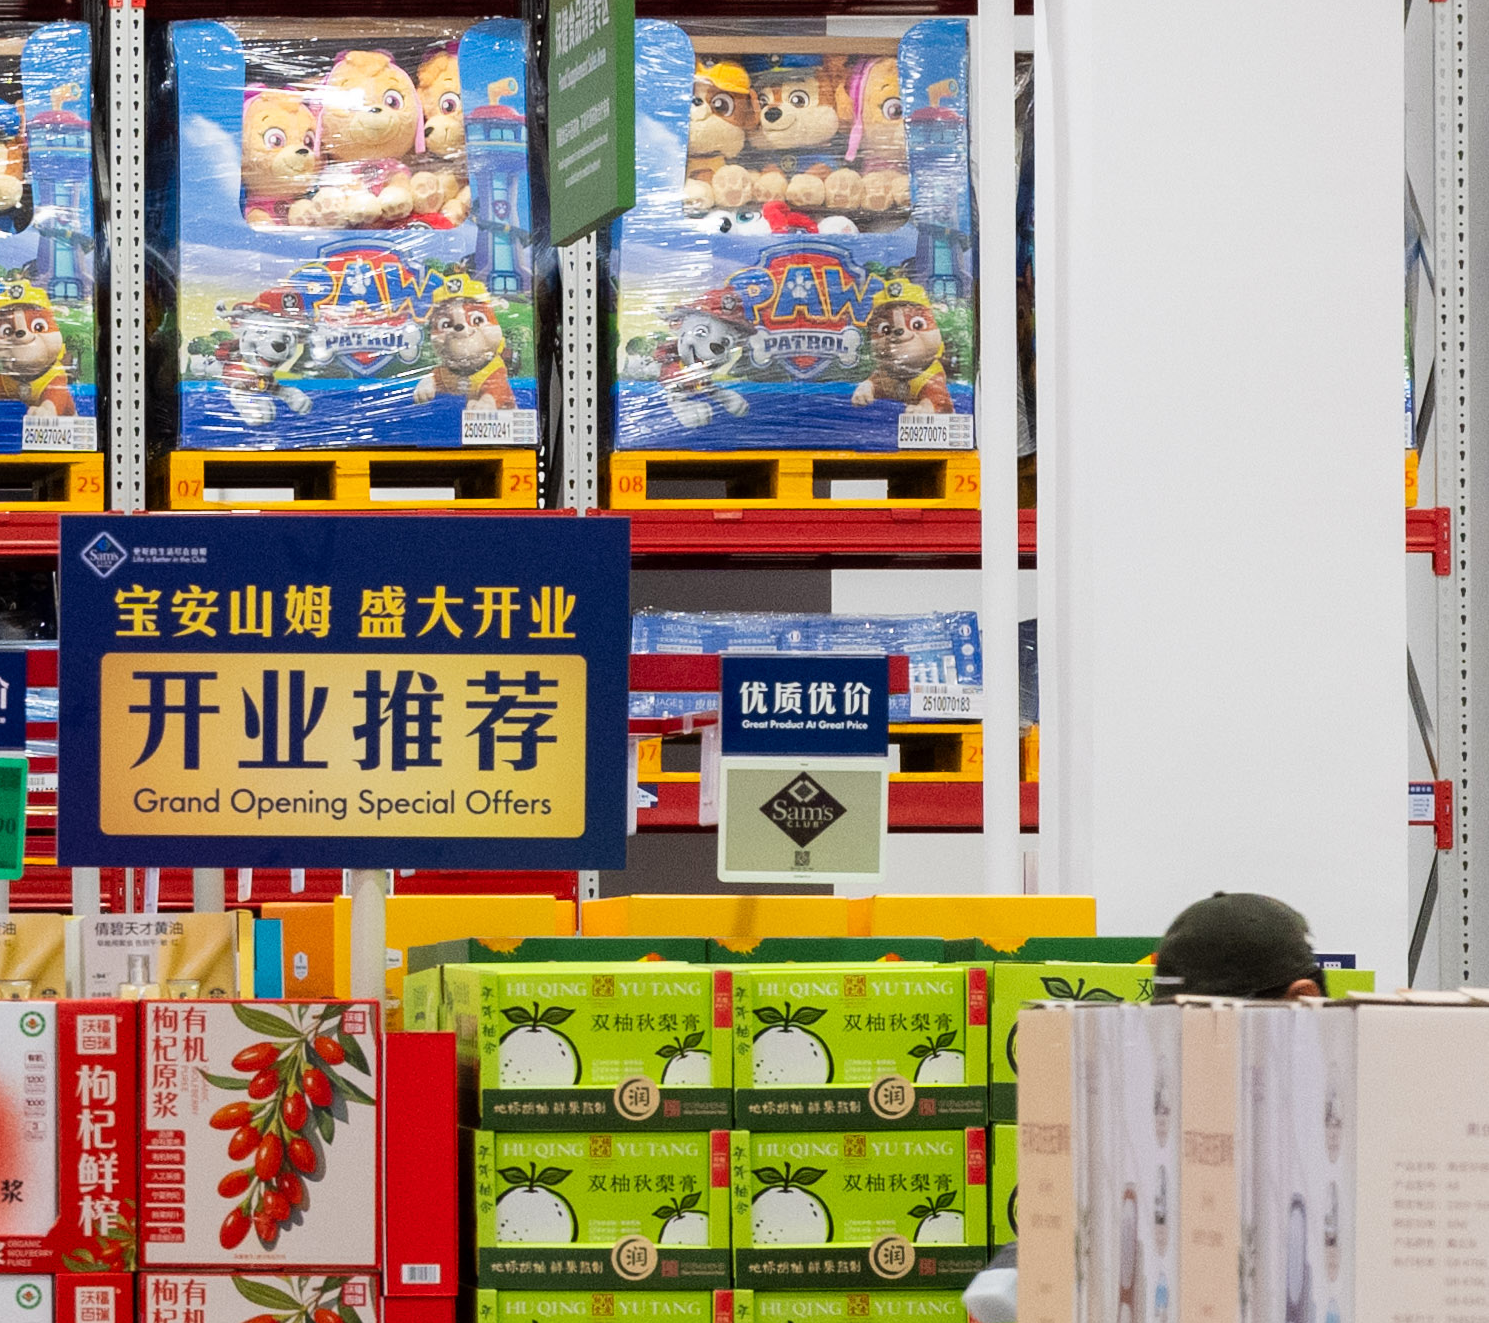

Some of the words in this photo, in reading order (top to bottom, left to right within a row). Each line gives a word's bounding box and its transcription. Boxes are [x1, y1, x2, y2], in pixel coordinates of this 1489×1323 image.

[463, 423, 511, 439] 2509270241
[899, 425, 947, 442] 2509270076
[619, 475, 644, 493] 08
[114, 584, 332, 638] 宝安山姆
[358, 586, 577, 639] 盛大开业
[739, 682, 871, 715] 优质优价
[923, 696, 970, 712] 2510070183
[129, 669, 559, 772] 开业推荐
[742, 720, 768, 729] Great
[770, 720, 804, 729] Product
[806, 720, 816, 729] At
[819, 720, 844, 730] Great
[847, 721, 868, 730] Price
[133, 788, 220, 814] Grand
[231, 788, 348, 820] Opening
[358, 789, 456, 820] Special
[466, 789, 552, 816] Offers
[773, 799, 834, 821] Sam's
[592, 1013, 700, 1032] 双柚秋梨膏
[843, 1014, 953, 1032] 双柚秋梨膏
[629, 1085, 650, 1106] 润
[494, 1100, 550, 1117] 地标胡柚
[76, 1063, 121, 1236] 枸杞鲜榨
